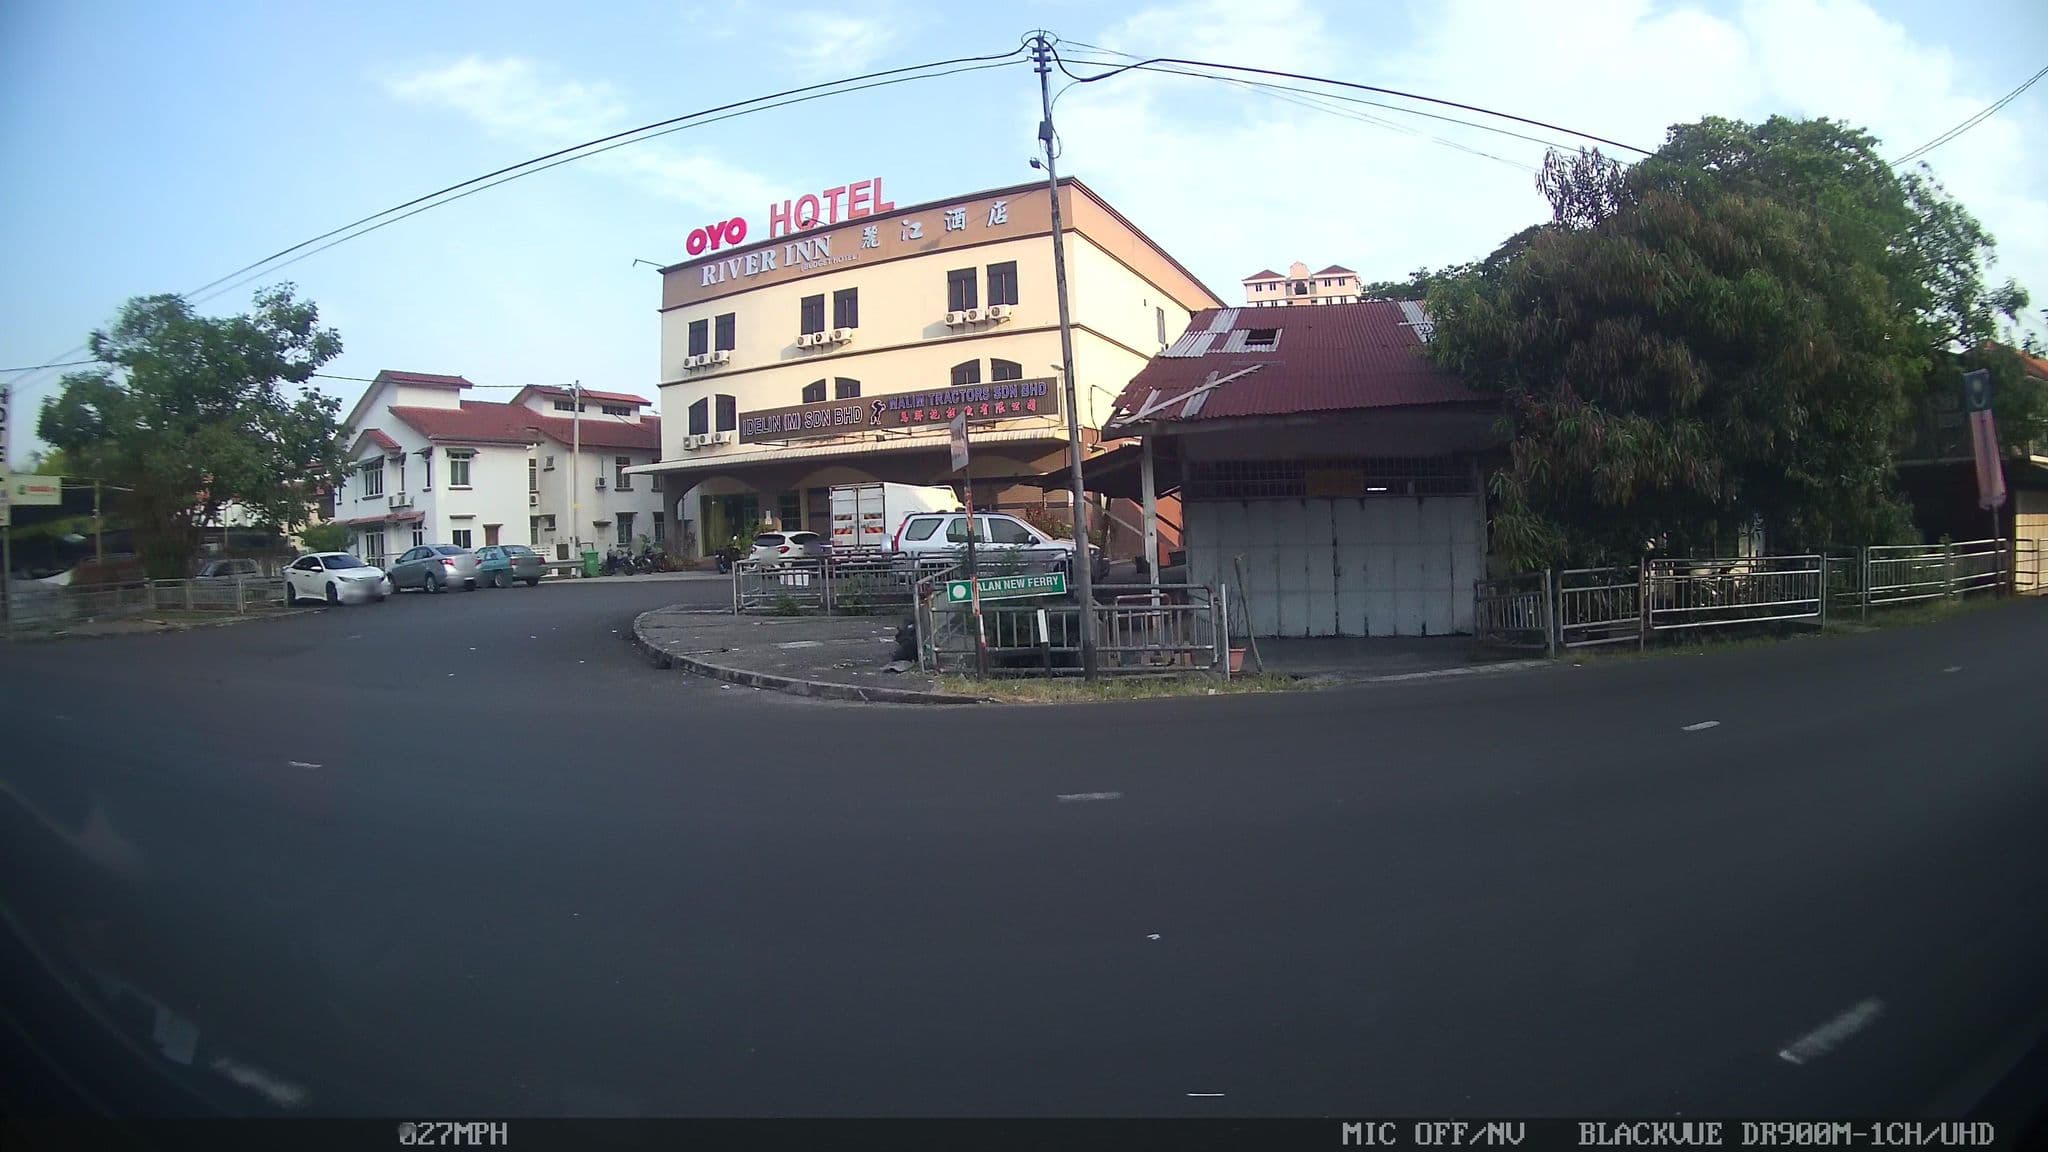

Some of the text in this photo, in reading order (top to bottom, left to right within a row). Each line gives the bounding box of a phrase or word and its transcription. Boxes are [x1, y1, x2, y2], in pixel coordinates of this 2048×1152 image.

[686, 176, 895, 256] OYO HOTEL
[700, 235, 832, 287] RIVER INN
[929, 387, 990, 406] TRACTORS
[993, 384, 1018, 400] SDN
[1021, 381, 1047, 397] BHD
[804, 409, 831, 429] SDN
[834, 405, 863, 425] BHD
[976, 575, 1058, 592] ALAN NEW FERRY
